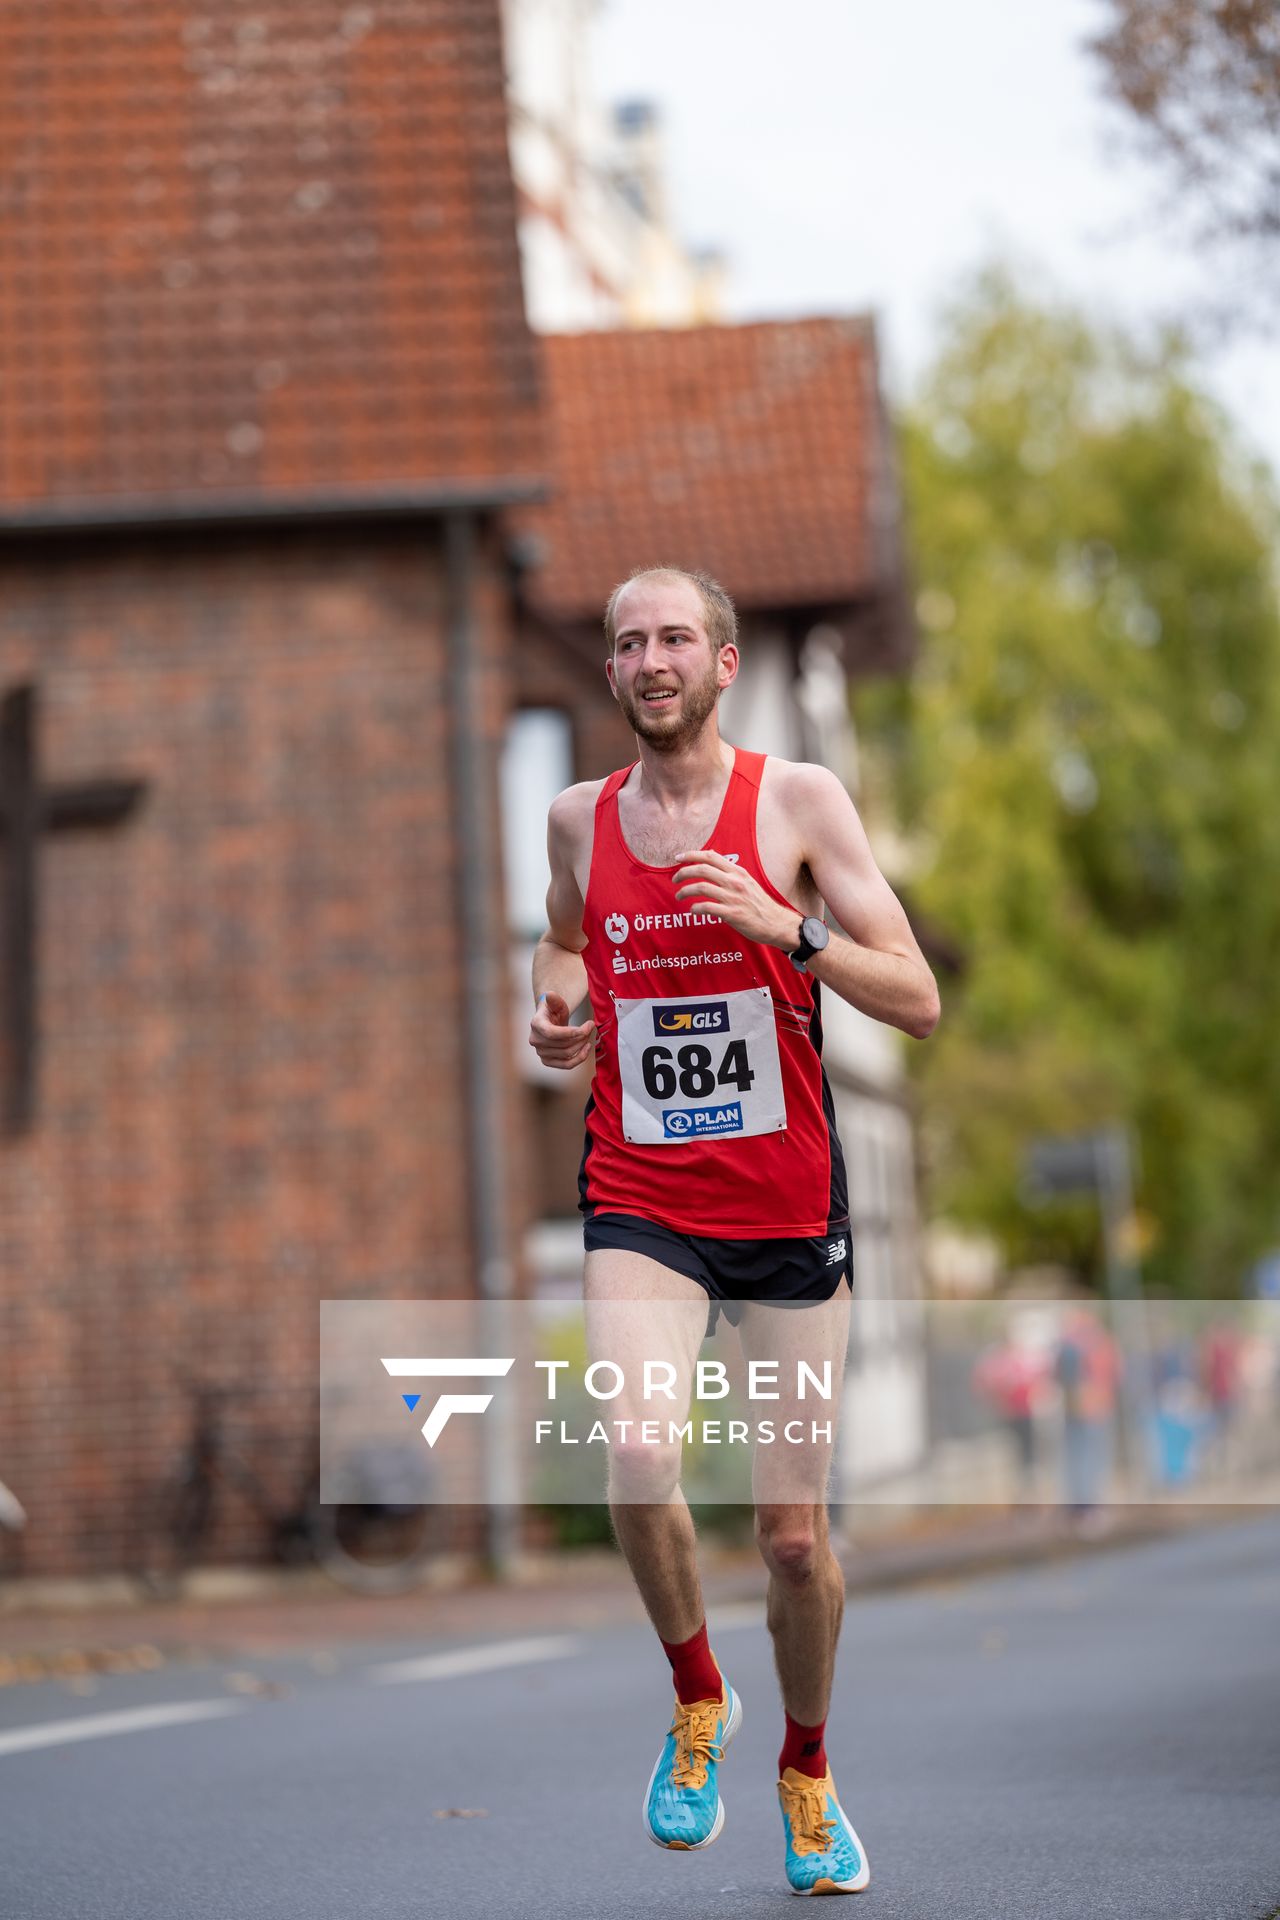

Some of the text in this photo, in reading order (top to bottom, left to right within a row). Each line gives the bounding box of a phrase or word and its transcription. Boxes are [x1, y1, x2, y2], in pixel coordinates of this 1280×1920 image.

[628, 951, 743, 972] Landessparkasse
[692, 1011, 722, 1029] GLS
[641, 1039, 755, 1100] 684
[694, 1108, 739, 1126] PLAN
[695, 1122, 740, 1132] INTERNATIONAL
